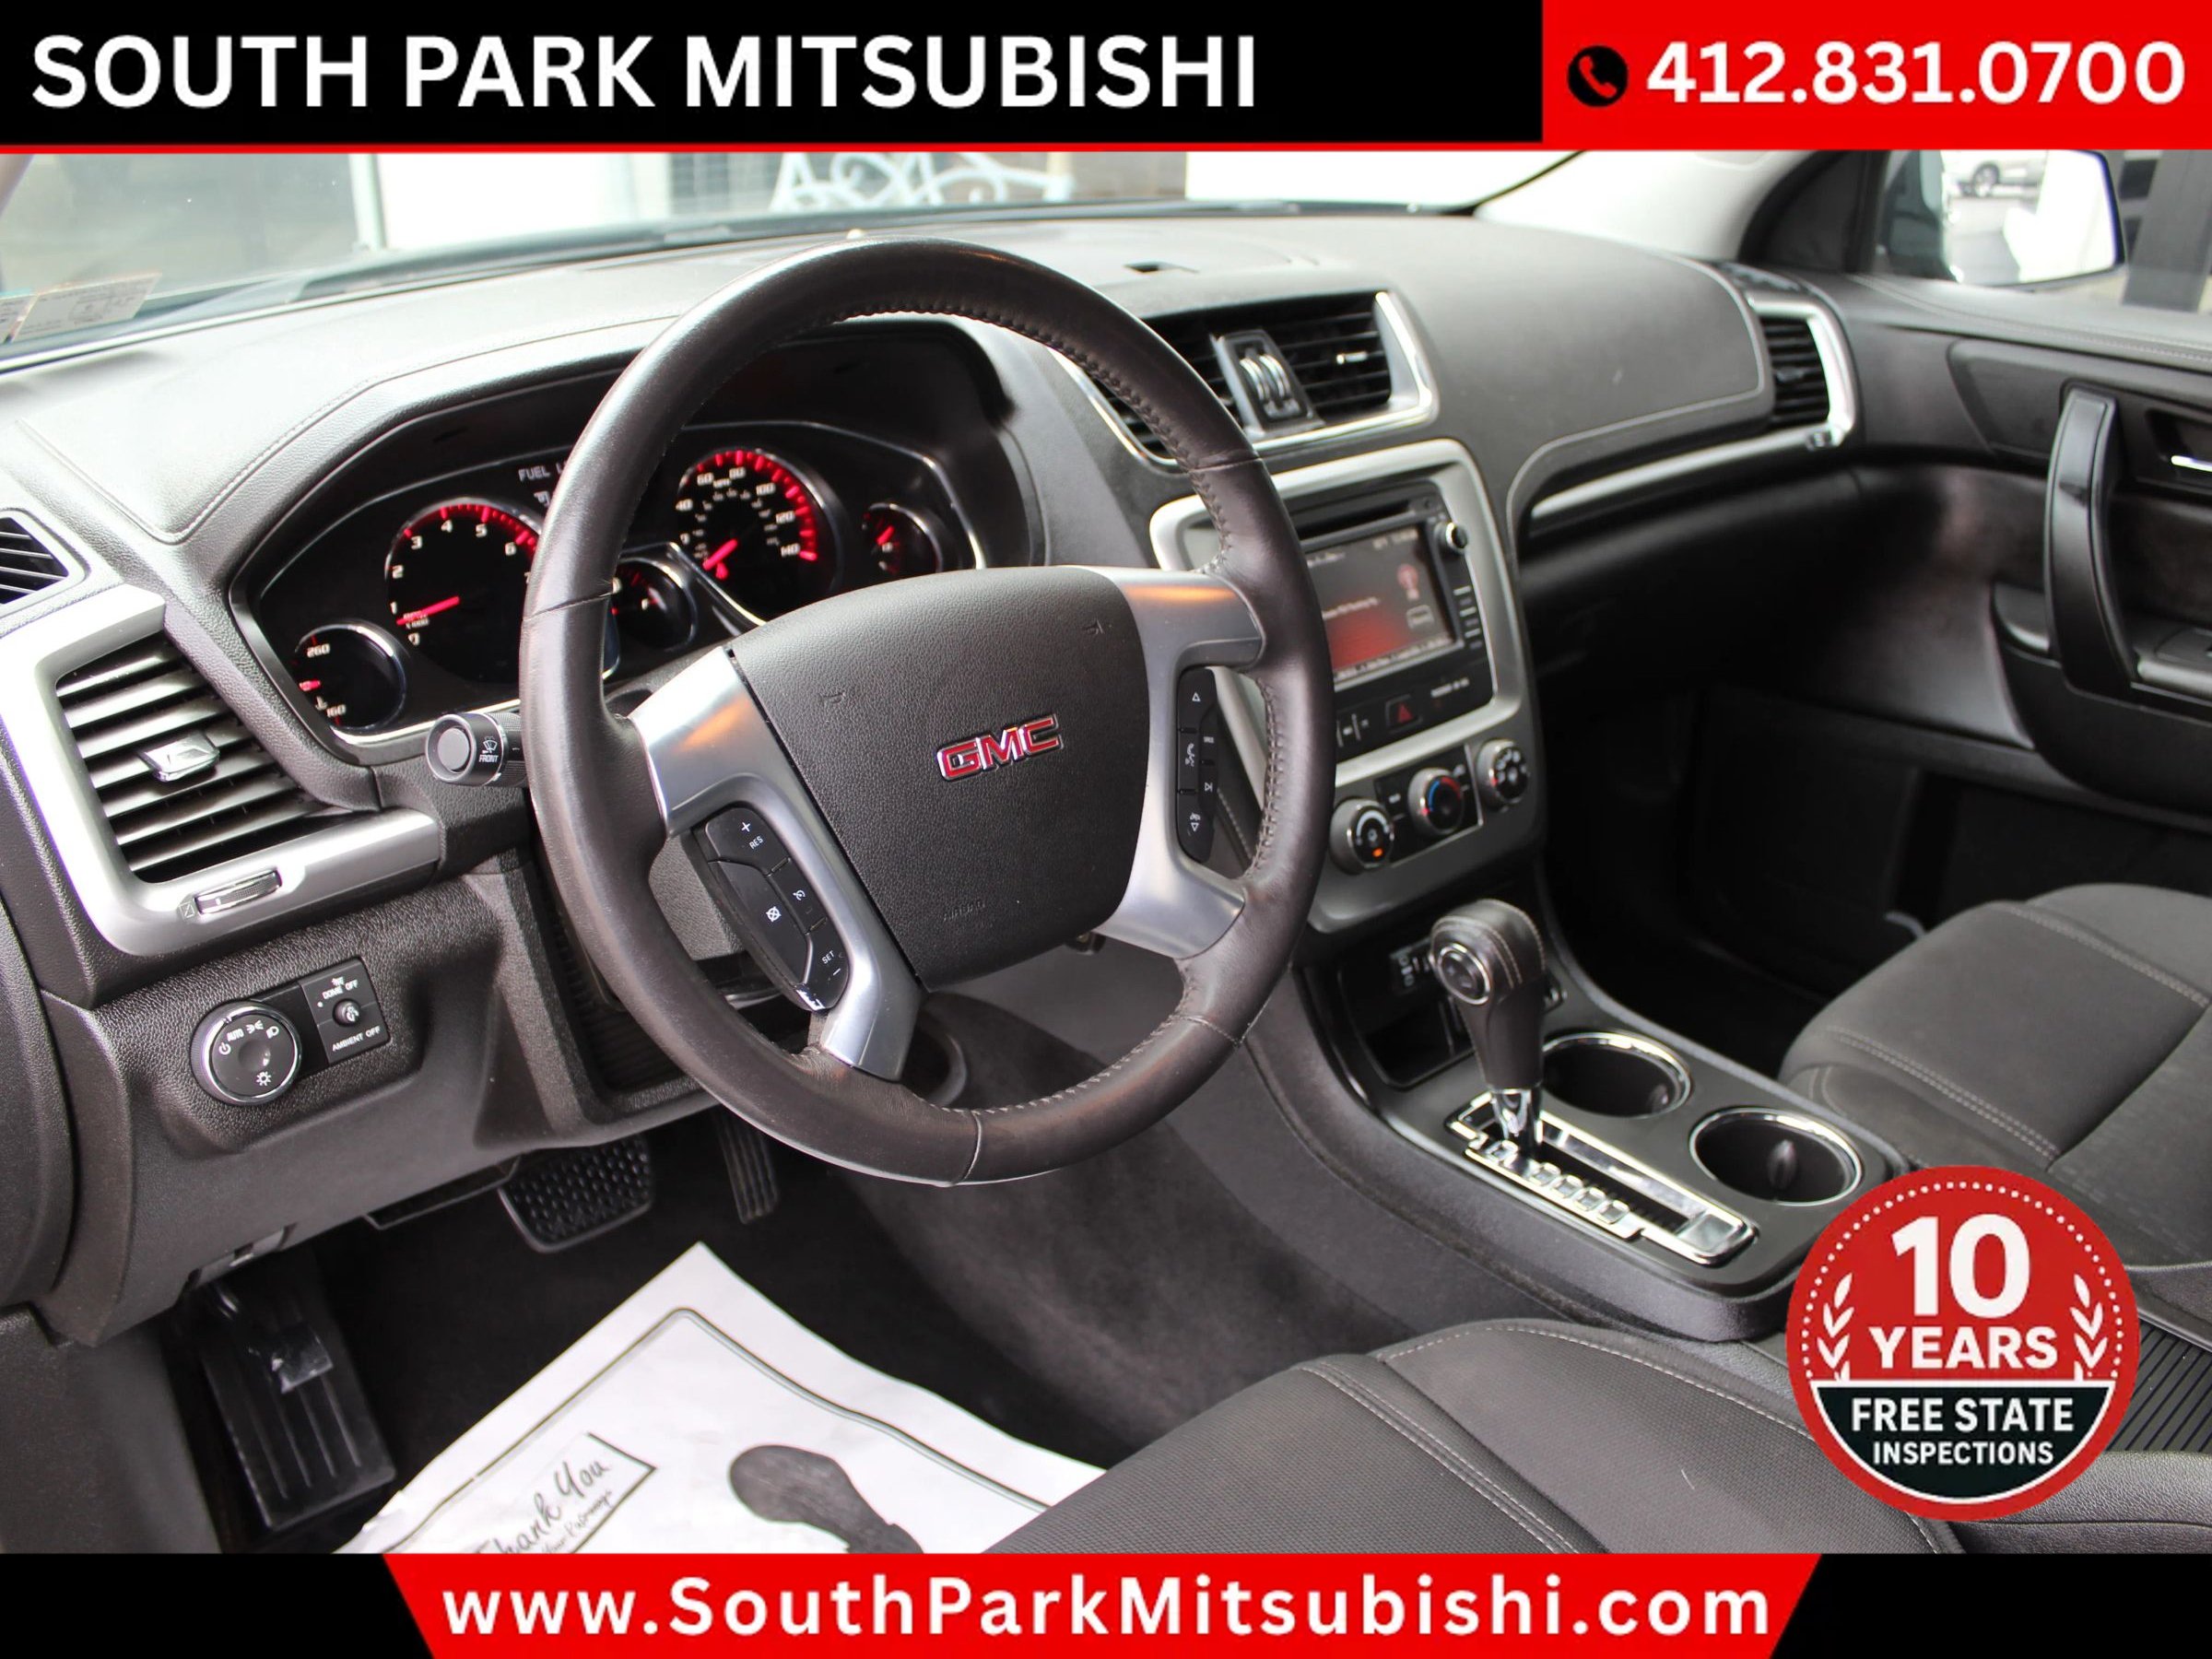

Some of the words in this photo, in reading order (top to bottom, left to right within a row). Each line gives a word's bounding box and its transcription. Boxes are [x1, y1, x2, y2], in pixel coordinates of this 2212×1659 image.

[518, 465, 551, 482] FUEL
[697, 472, 714, 486] 60
[756, 482, 776, 496] 100
[676, 499, 693, 512] 40
[776, 510, 795, 524] 120
[441, 520, 453, 533] 4
[476, 524, 488, 537] 5
[411, 535, 423, 549] 3
[505, 541, 516, 556] 6
[392, 564, 404, 579] 2
[390, 601, 397, 615] 1
[408, 632, 420, 646] 0
[307, 643, 330, 658] 260
[936, 713, 1065, 782] GMC
[478, 754, 499, 763] FRONT
[748, 835, 764, 850] RES
[821, 950, 835, 965] SET
[322, 987, 343, 1000] DOME
[345, 979, 359, 991] OFF
[227, 1028, 244, 1041] AUTO
[332, 1032, 364, 1052] AMBIENT
[365, 1025, 381, 1038] OFF
[554, 1462, 610, 1498] You
